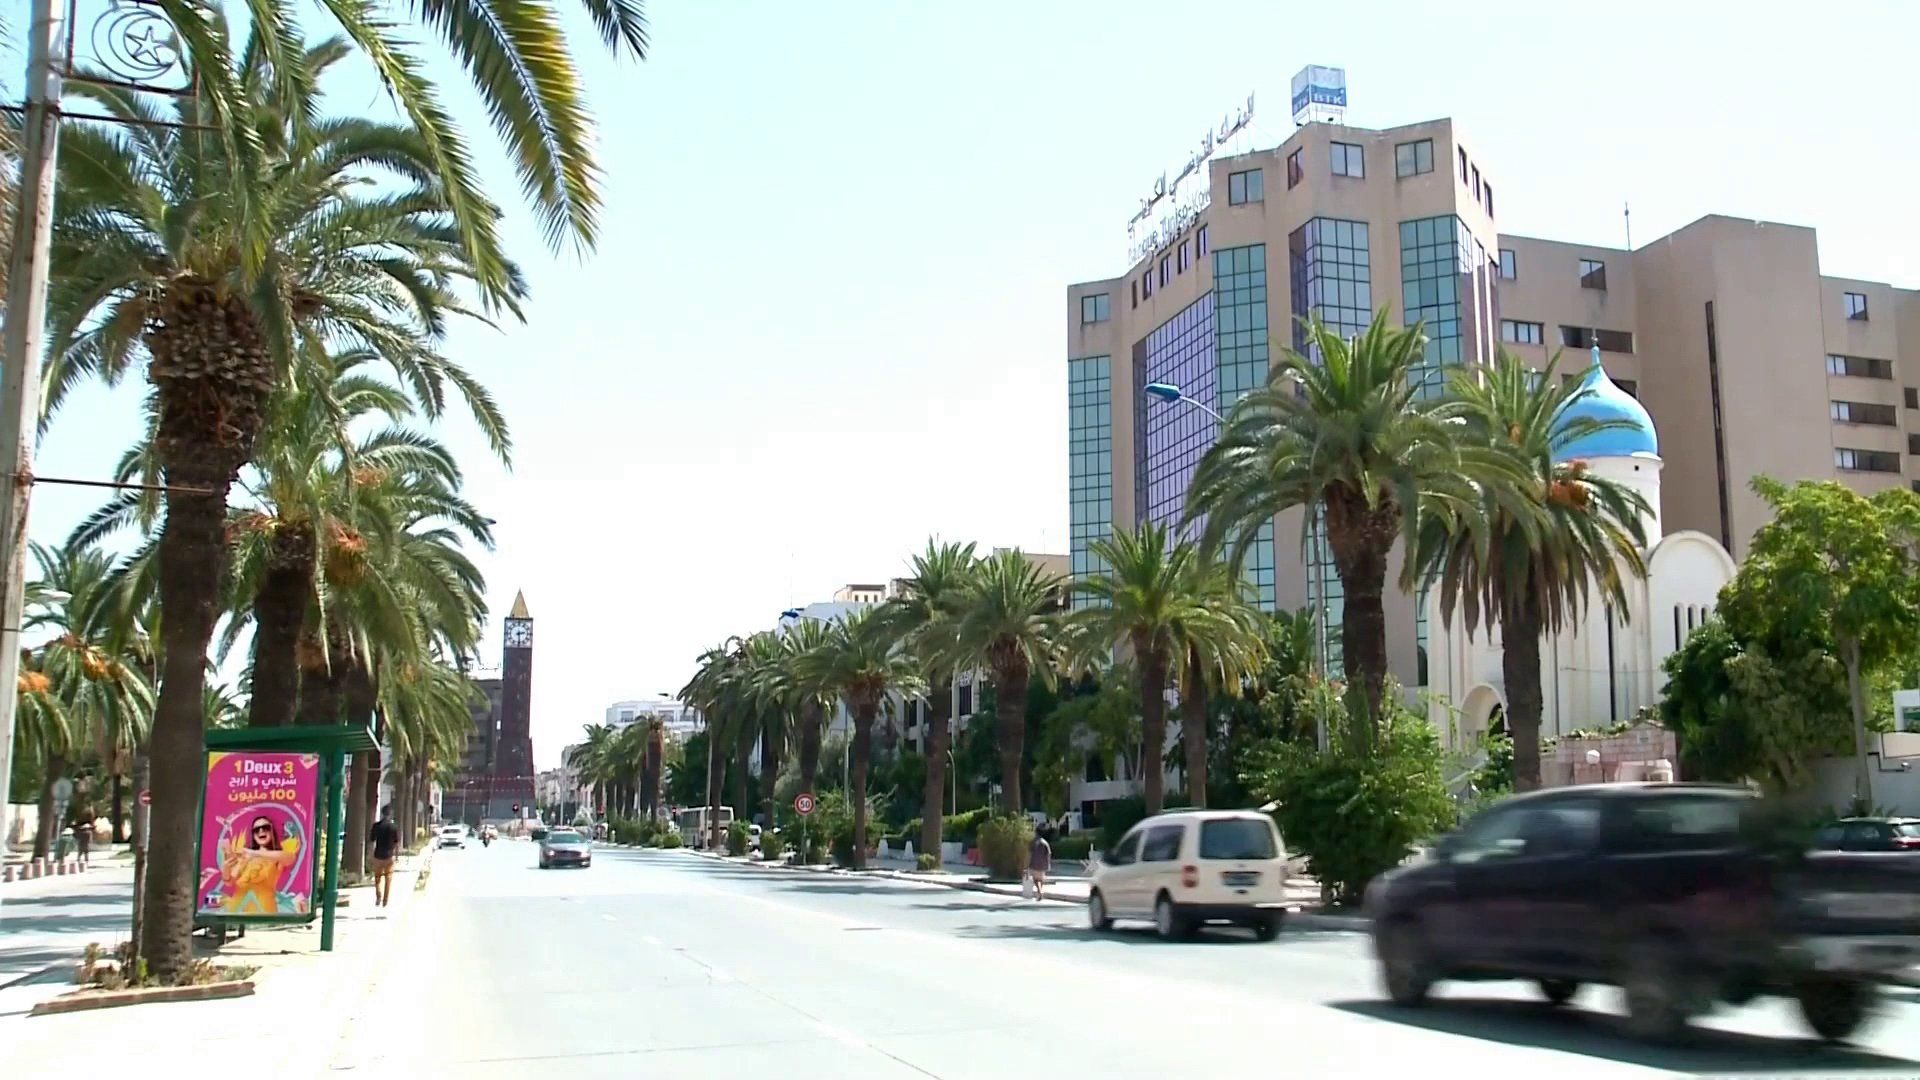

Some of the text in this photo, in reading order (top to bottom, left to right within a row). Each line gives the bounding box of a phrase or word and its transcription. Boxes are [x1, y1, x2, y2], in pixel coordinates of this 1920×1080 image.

[234, 760, 294, 774] 1 Deux 3
[251, 777, 259, 786] و
[228, 789, 296, 803] 100 مليون
[800, 800, 811, 808] 50
